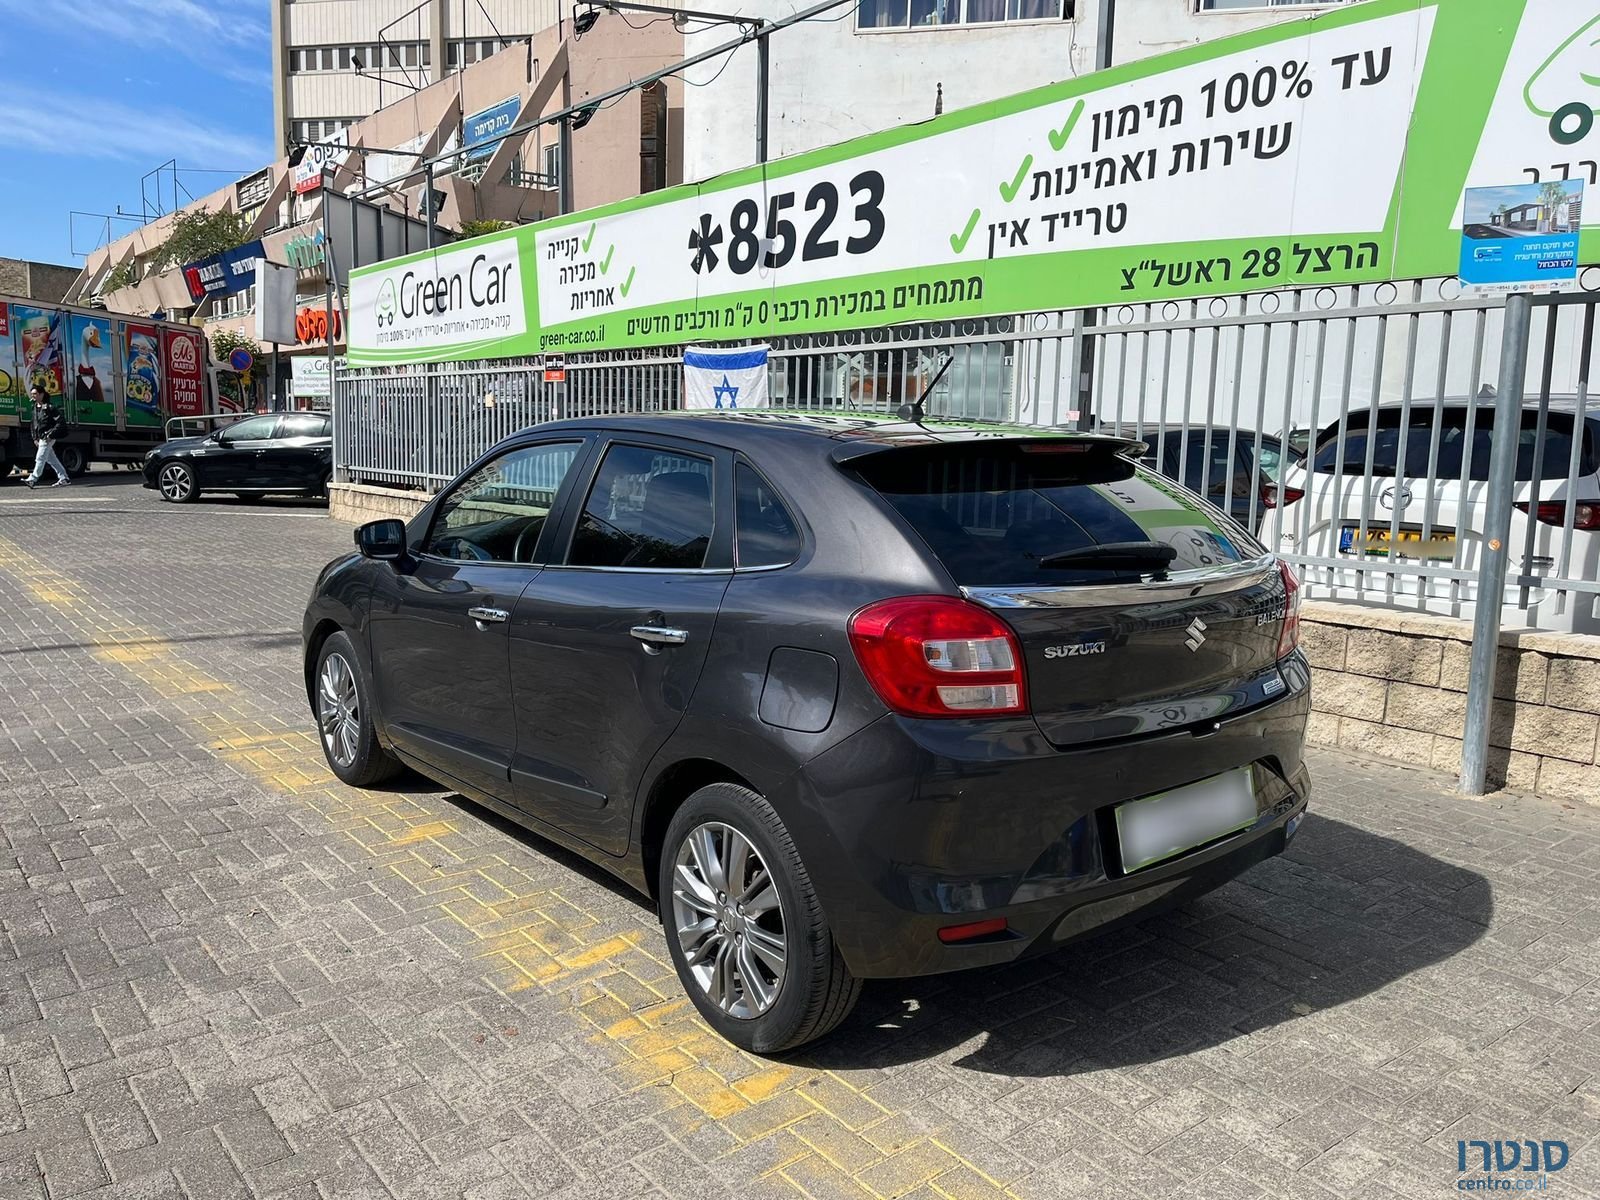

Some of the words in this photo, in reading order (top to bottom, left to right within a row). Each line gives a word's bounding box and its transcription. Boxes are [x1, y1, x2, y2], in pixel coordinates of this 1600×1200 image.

[1331, 46, 1392, 91] עד
[1200, 60, 1313, 119] 100%
[474, 119, 495, 137] קדימה
[496, 114, 510, 128] בית
[1091, 94, 1183, 152] מימון
[1168, 121, 1293, 177] שירות
[1030, 149, 1156, 201] ואמינות
[1041, 201, 1128, 243] טרייד
[548, 237, 579, 261] קנייה
[988, 216, 1031, 260] אין
[1241, 247, 1281, 280] 28
[1292, 241, 1379, 274] הרצל
[1538, 260, 1559, 268] הכחול
[559, 261, 596, 285] מכירה
[1120, 257, 1231, 292] ראשל"צ
[400, 271, 462, 319] Green
[469, 254, 512, 308] Car
[570, 286, 615, 311] אחריות
[893, 275, 983, 307] מתמחים
[758, 304, 768, 325] 0
[774, 299, 809, 323] רכבי
[814, 289, 886, 318] במכירת
[443, 321, 466, 335] אחריות
[470, 317, 490, 331] מכירה
[494, 314, 511, 331] קניה
[627, 314, 670, 336] חדשים
[674, 308, 719, 332] ורכבים
[539, 324, 605, 350] green-car.co.il
[173, 361, 196, 371] MARTIN
[173, 377, 197, 390] גרעיני
[1044, 642, 1105, 659] SUZUKI
